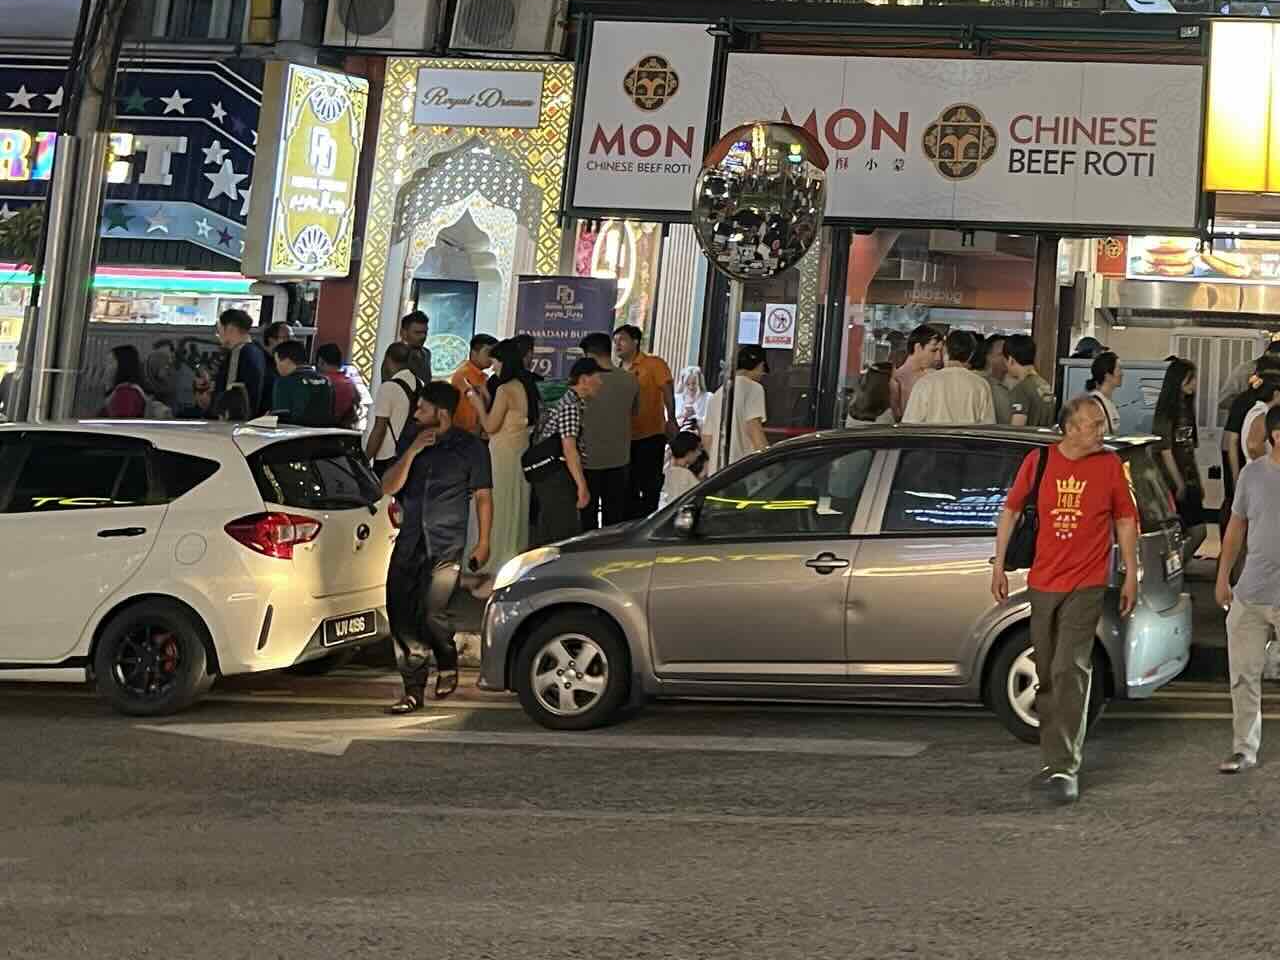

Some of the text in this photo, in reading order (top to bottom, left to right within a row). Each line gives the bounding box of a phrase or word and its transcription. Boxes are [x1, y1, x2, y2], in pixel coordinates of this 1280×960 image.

[589, 123, 695, 159] MON
[1009, 114, 1158, 147] CHINESE
[586, 160, 691, 174] CHINESE BEEF ROTI
[1008, 148, 1155, 177] BEEF ROTI
